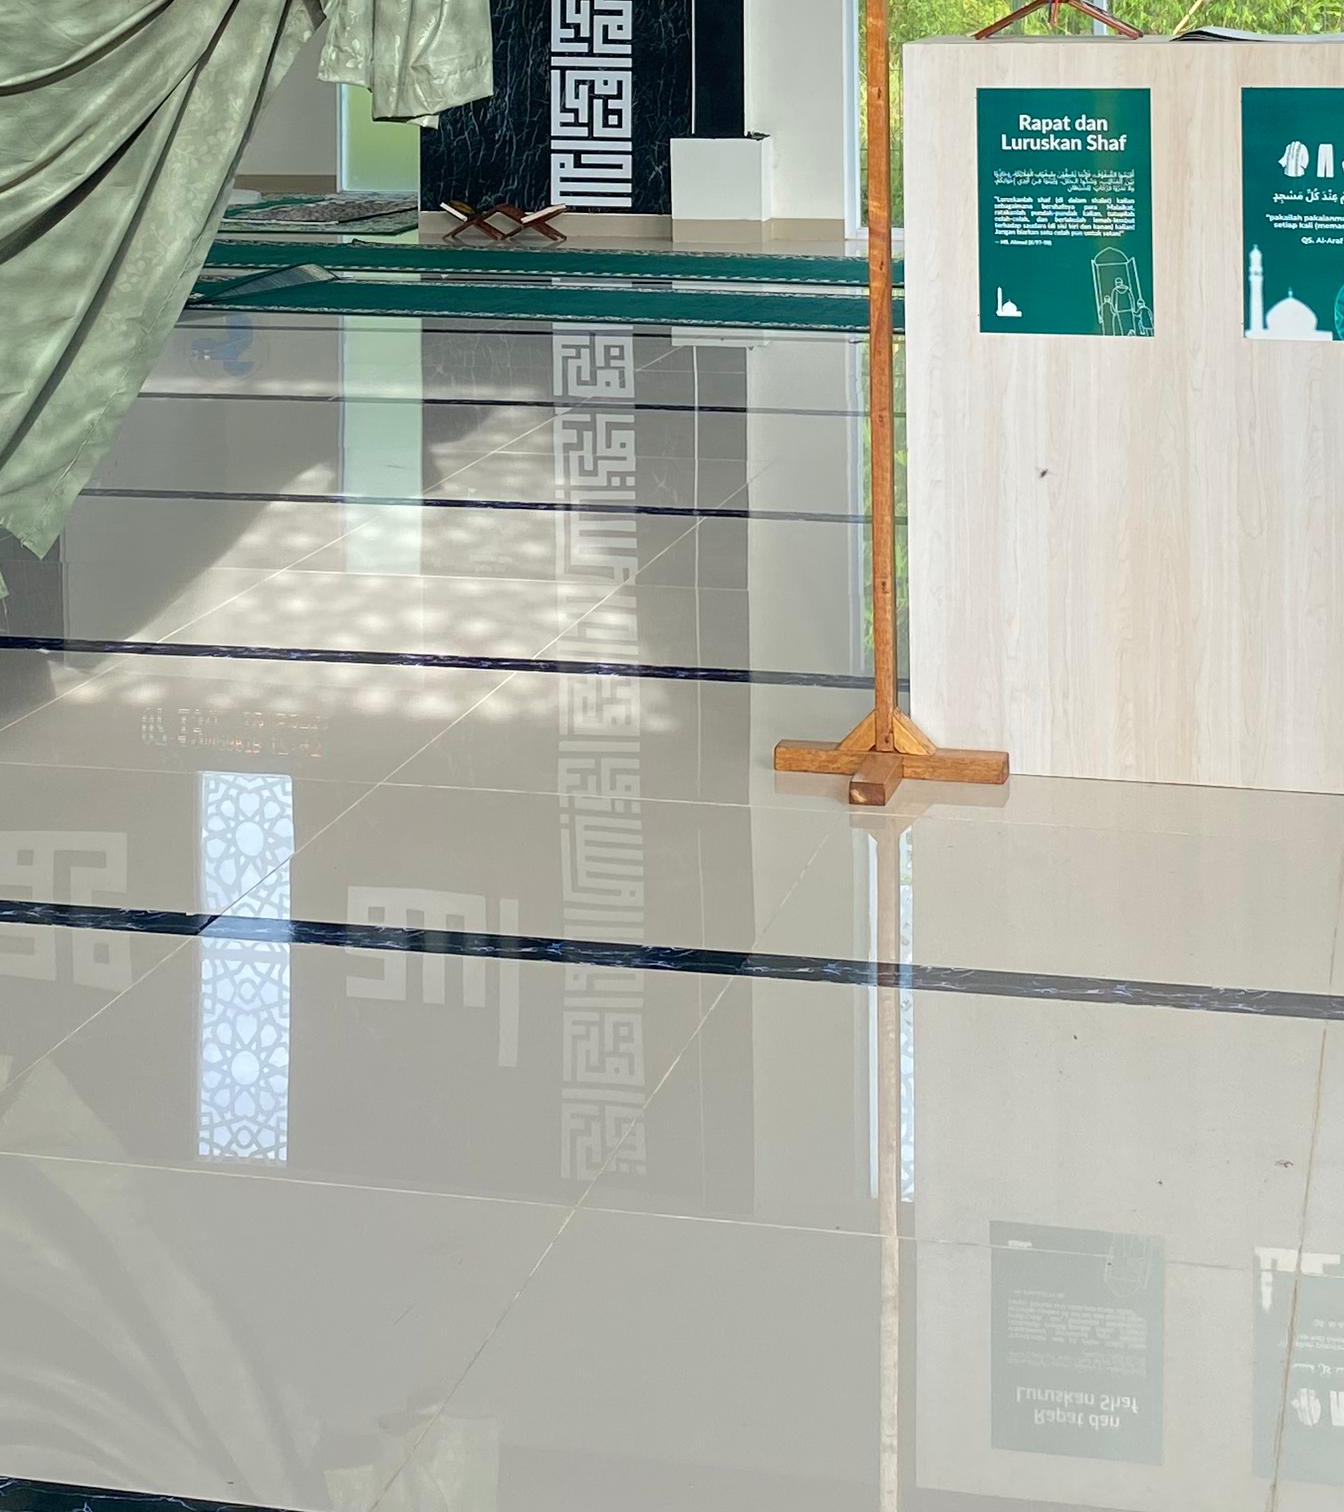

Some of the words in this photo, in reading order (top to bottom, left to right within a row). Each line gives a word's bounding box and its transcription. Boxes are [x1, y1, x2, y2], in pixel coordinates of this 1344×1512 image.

[1019, 114, 1071, 134] Rapat
[1074, 114, 1108, 131] dan
[1001, 134, 1082, 151] Luruskan
[1086, 134, 1127, 151] Shaf
